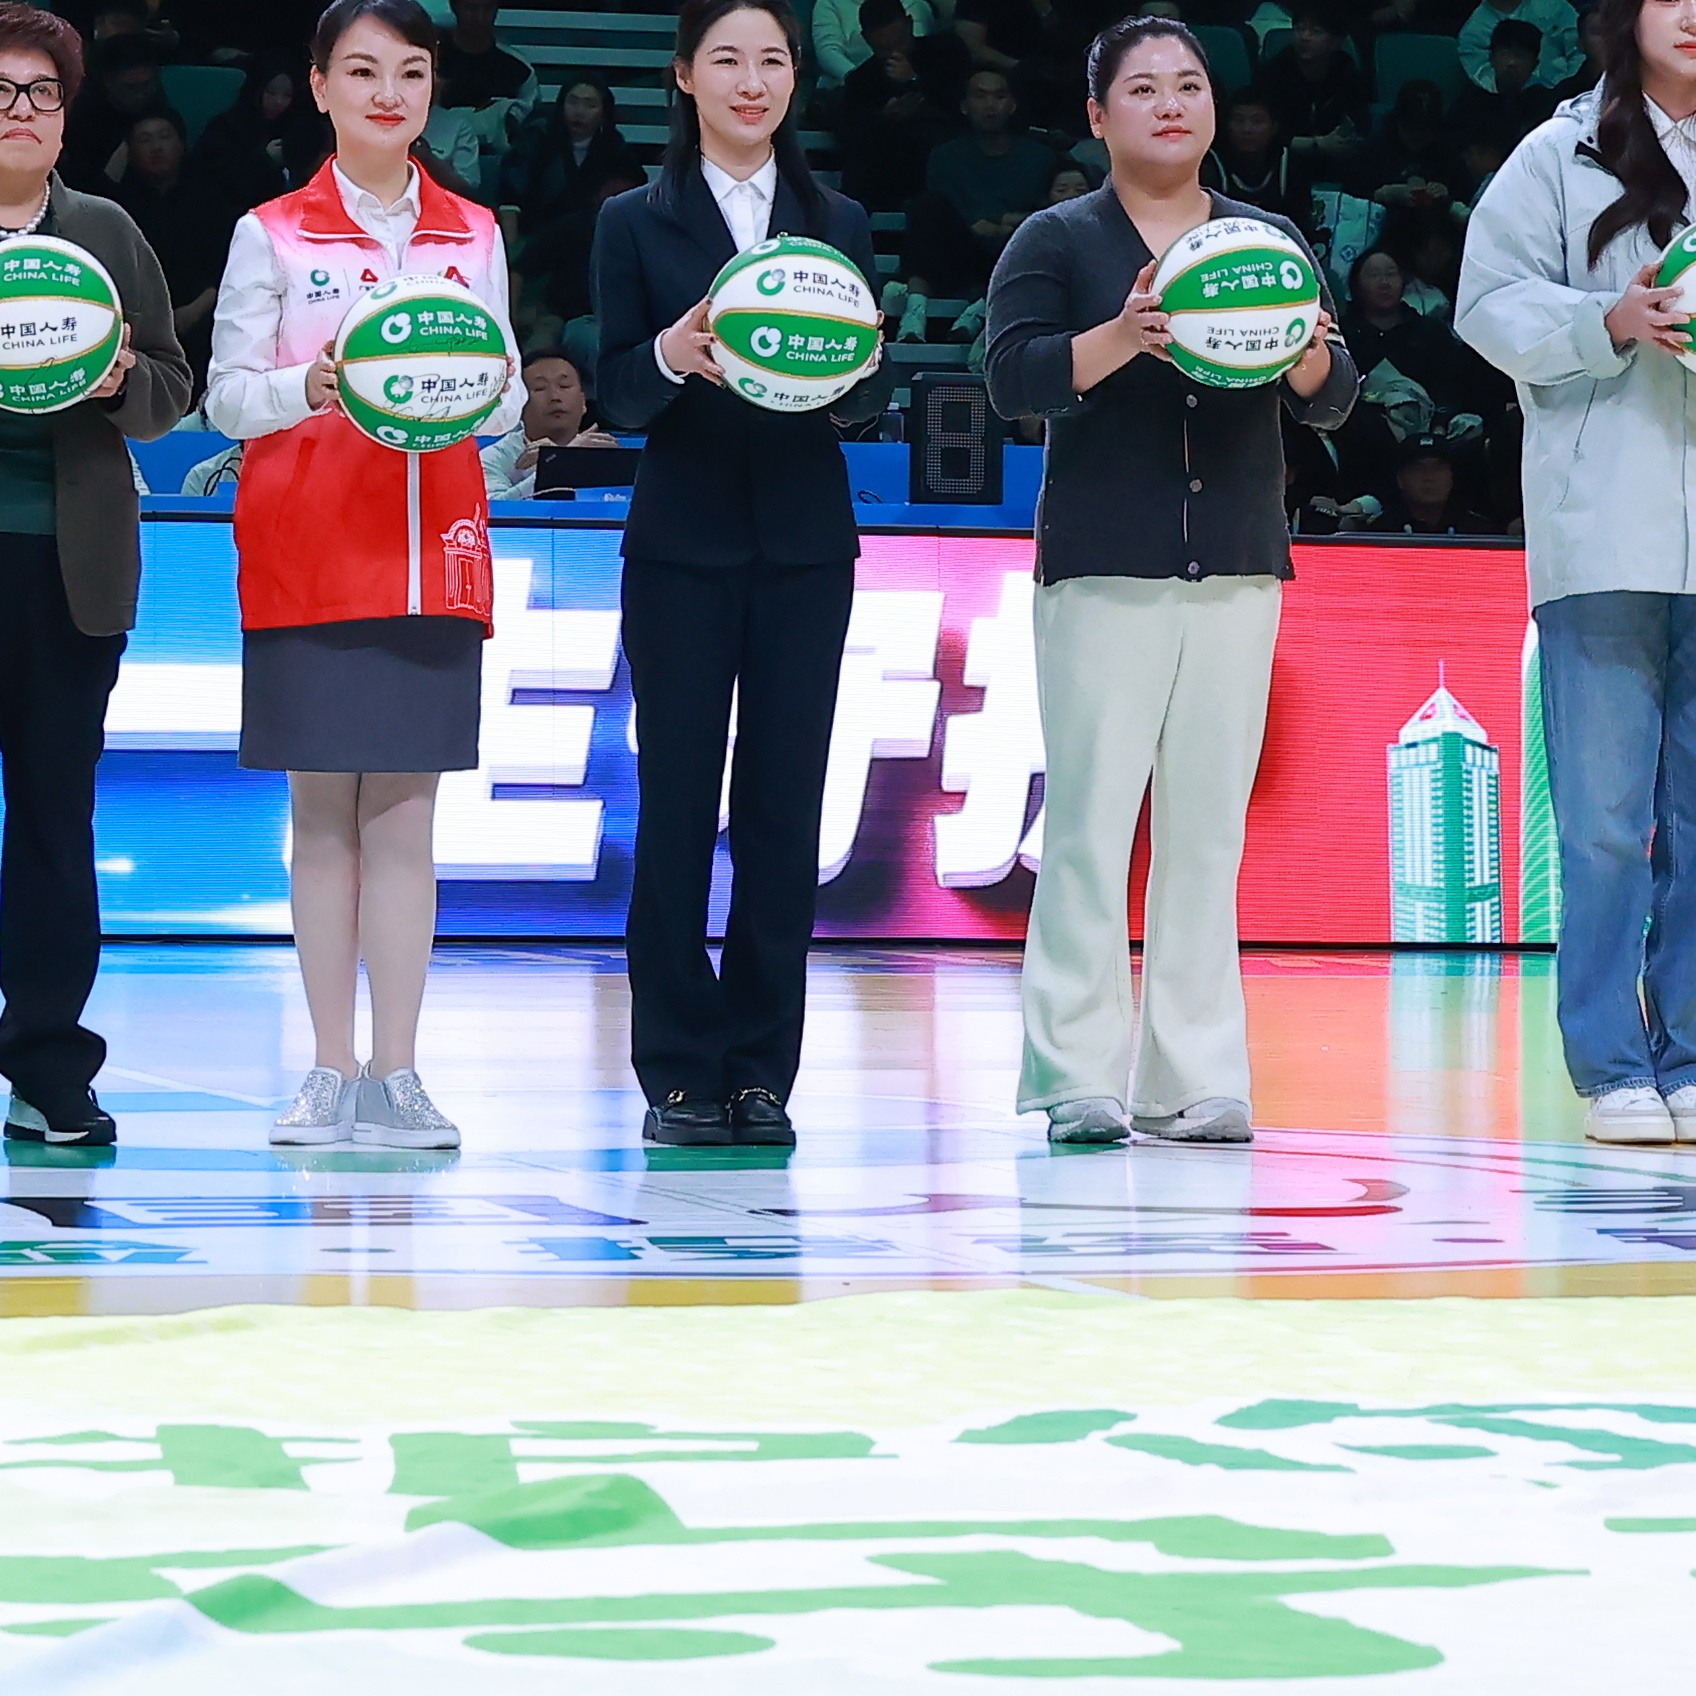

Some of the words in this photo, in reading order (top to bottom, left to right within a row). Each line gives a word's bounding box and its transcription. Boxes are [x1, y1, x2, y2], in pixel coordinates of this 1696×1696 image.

[3, 258, 82, 277] 中国人寿
[1199, 268, 1229, 284] LIFE
[1231, 261, 1275, 275] CHINA
[3, 271, 48, 283] CHINA
[51, 272, 81, 288] LIFE
[793, 270, 861, 298] 中国人寿
[1202, 272, 1278, 299] 中国人寿
[793, 285, 835, 298] CHINA
[837, 293, 861, 309] LIFE
[0, 316, 78, 340] 中国人寿
[416, 310, 489, 331] 中国人寿
[419, 326, 463, 337] CHINA
[465, 327, 489, 342] LIFE
[1206, 326, 1236, 337] LIFE
[1240, 326, 1280, 336] CHINA
[1, 340, 47, 351] CHINA
[49, 333, 79, 346] LIFE
[787, 333, 859, 352] 中国人寿
[1205, 336, 1279, 352] 中国人寿
[786, 350, 828, 363] CHINA
[830, 352, 856, 363] LIFE
[420, 372, 490, 394] 中国人寿
[420, 394, 463, 405] CHINA
[465, 389, 489, 401] LIFE
